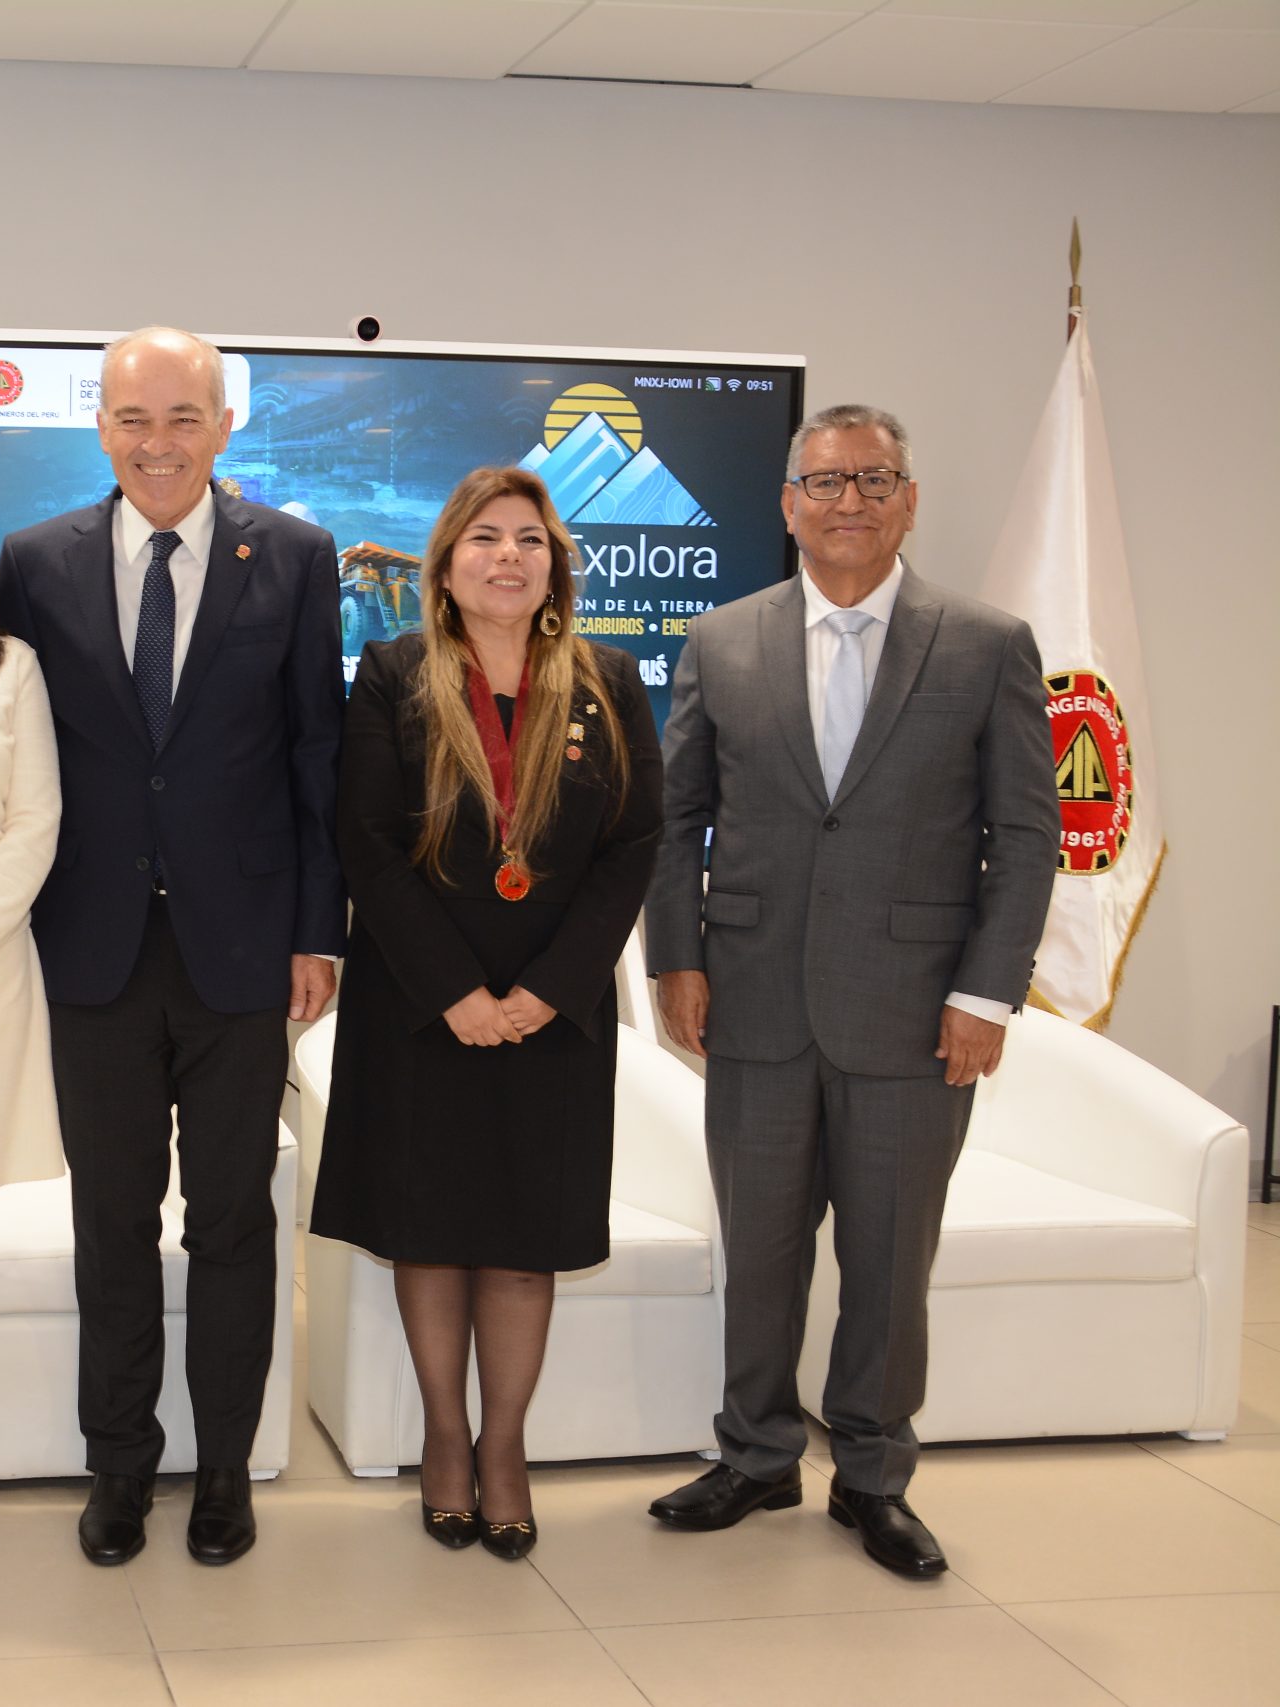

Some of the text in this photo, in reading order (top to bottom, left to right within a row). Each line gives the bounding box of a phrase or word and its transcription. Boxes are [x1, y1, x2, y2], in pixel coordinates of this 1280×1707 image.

[746, 380, 773, 391] 09:51
[605, 599, 626, 612] DE
[633, 600, 653, 613] LA
[660, 600, 715, 613] TIERRA
[1044, 695, 1120, 741] NGENIEROS
[1059, 830, 1107, 848] 1962
